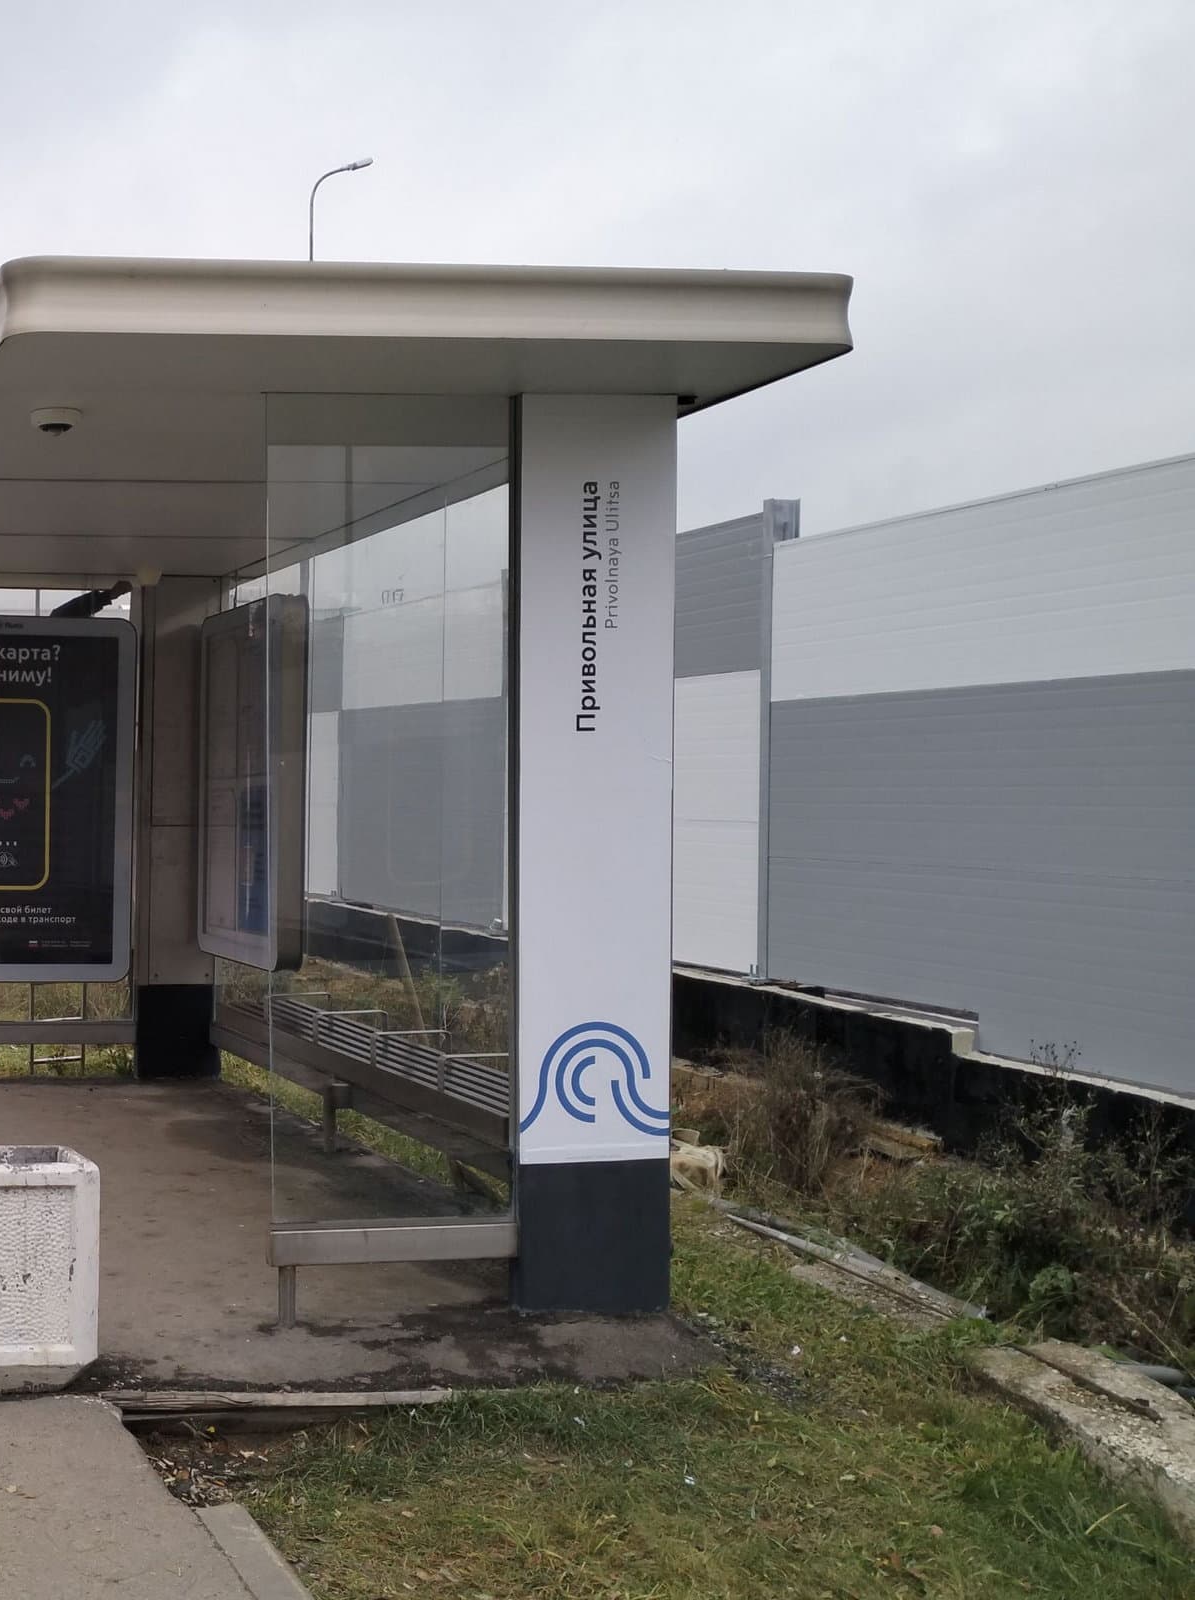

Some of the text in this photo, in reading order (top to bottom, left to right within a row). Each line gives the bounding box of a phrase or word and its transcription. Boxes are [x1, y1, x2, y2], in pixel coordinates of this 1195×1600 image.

[604, 480, 622, 629] Privolnaya Ulitsa
[576, 480, 602, 732] Привольная улица
[0, 905, 22, 914] свой
[24, 904, 52, 914] билет
[27, 916, 77, 925] транспорт
